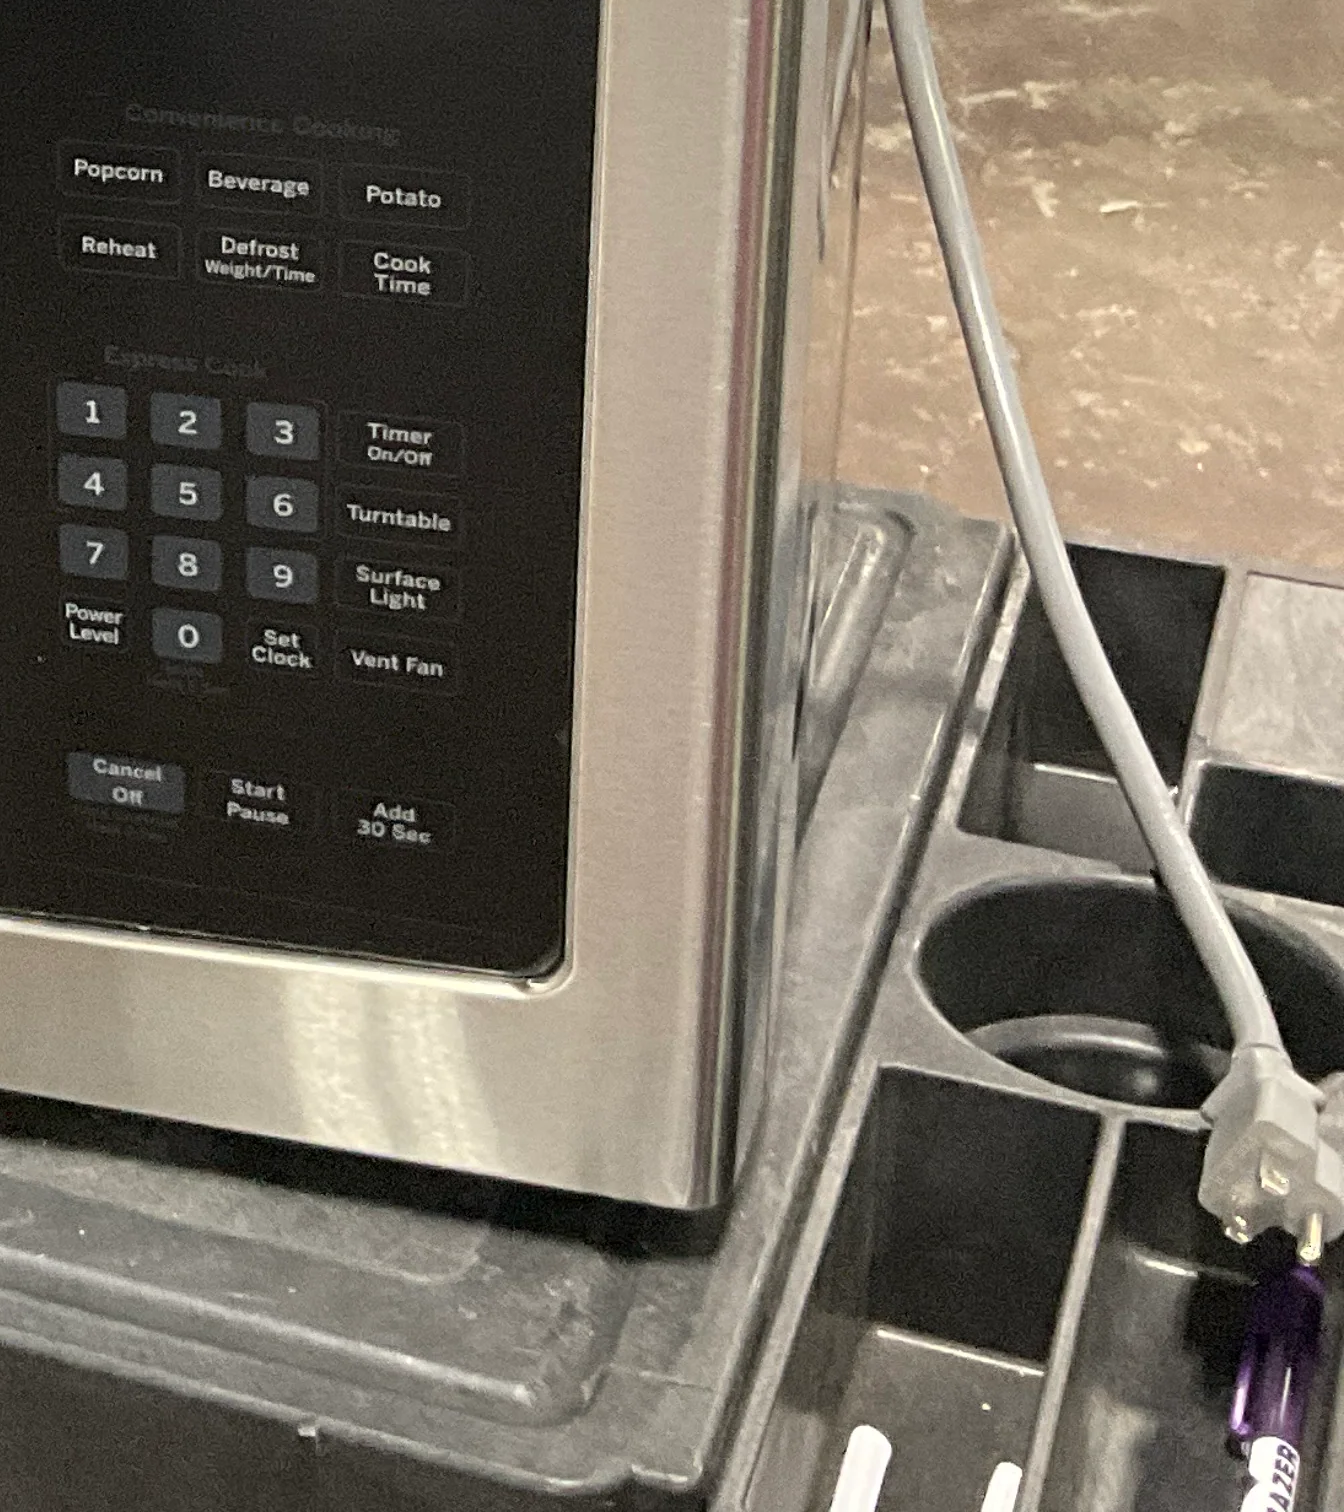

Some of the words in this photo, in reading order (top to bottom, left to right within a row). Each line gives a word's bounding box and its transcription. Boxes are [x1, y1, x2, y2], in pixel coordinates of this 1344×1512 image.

[292, 114, 401, 147] Cooking
[74, 158, 164, 183] Popcorn
[208, 169, 310, 198] Beverage
[366, 184, 442, 209] Potato
[81, 235, 157, 259] Reheat
[221, 235, 299, 260] Defrost
[204, 259, 316, 284] Weight/Time
[373, 251, 431, 273] Cook
[373, 273, 431, 296] Time
[86, 400, 100, 424] 1
[178, 410, 197, 435] 2
[274, 420, 294, 445] 3
[366, 421, 433, 445] Timer
[366, 445, 433, 467] On/Off
[83, 472, 105, 496] 4
[179, 481, 198, 506] 5
[273, 493, 294, 517] 6
[346, 503, 451, 532] Turntable
[86, 541, 104, 565] 7
[178, 553, 198, 577] 8
[273, 564, 293, 588] 9
[356, 564, 441, 591] Surface
[369, 587, 427, 610] Light
[65, 602, 124, 625] Power
[69, 622, 121, 645] Level
[178, 624, 200, 649] 0
[264, 629, 300, 649] Set
[251, 645, 312, 669] Clock
[351, 650, 399, 672] Vent
[405, 656, 444, 677] Fan
[92, 757, 163, 782] Cancel
[112, 786, 144, 806] Off
[231, 778, 285, 802] Start
[226, 800, 290, 826] Pause
[374, 802, 416, 823] Add
[357, 819, 385, 838] 30
[391, 823, 431, 845] Sec
[1266, 1444, 1297, 1512] AZER
